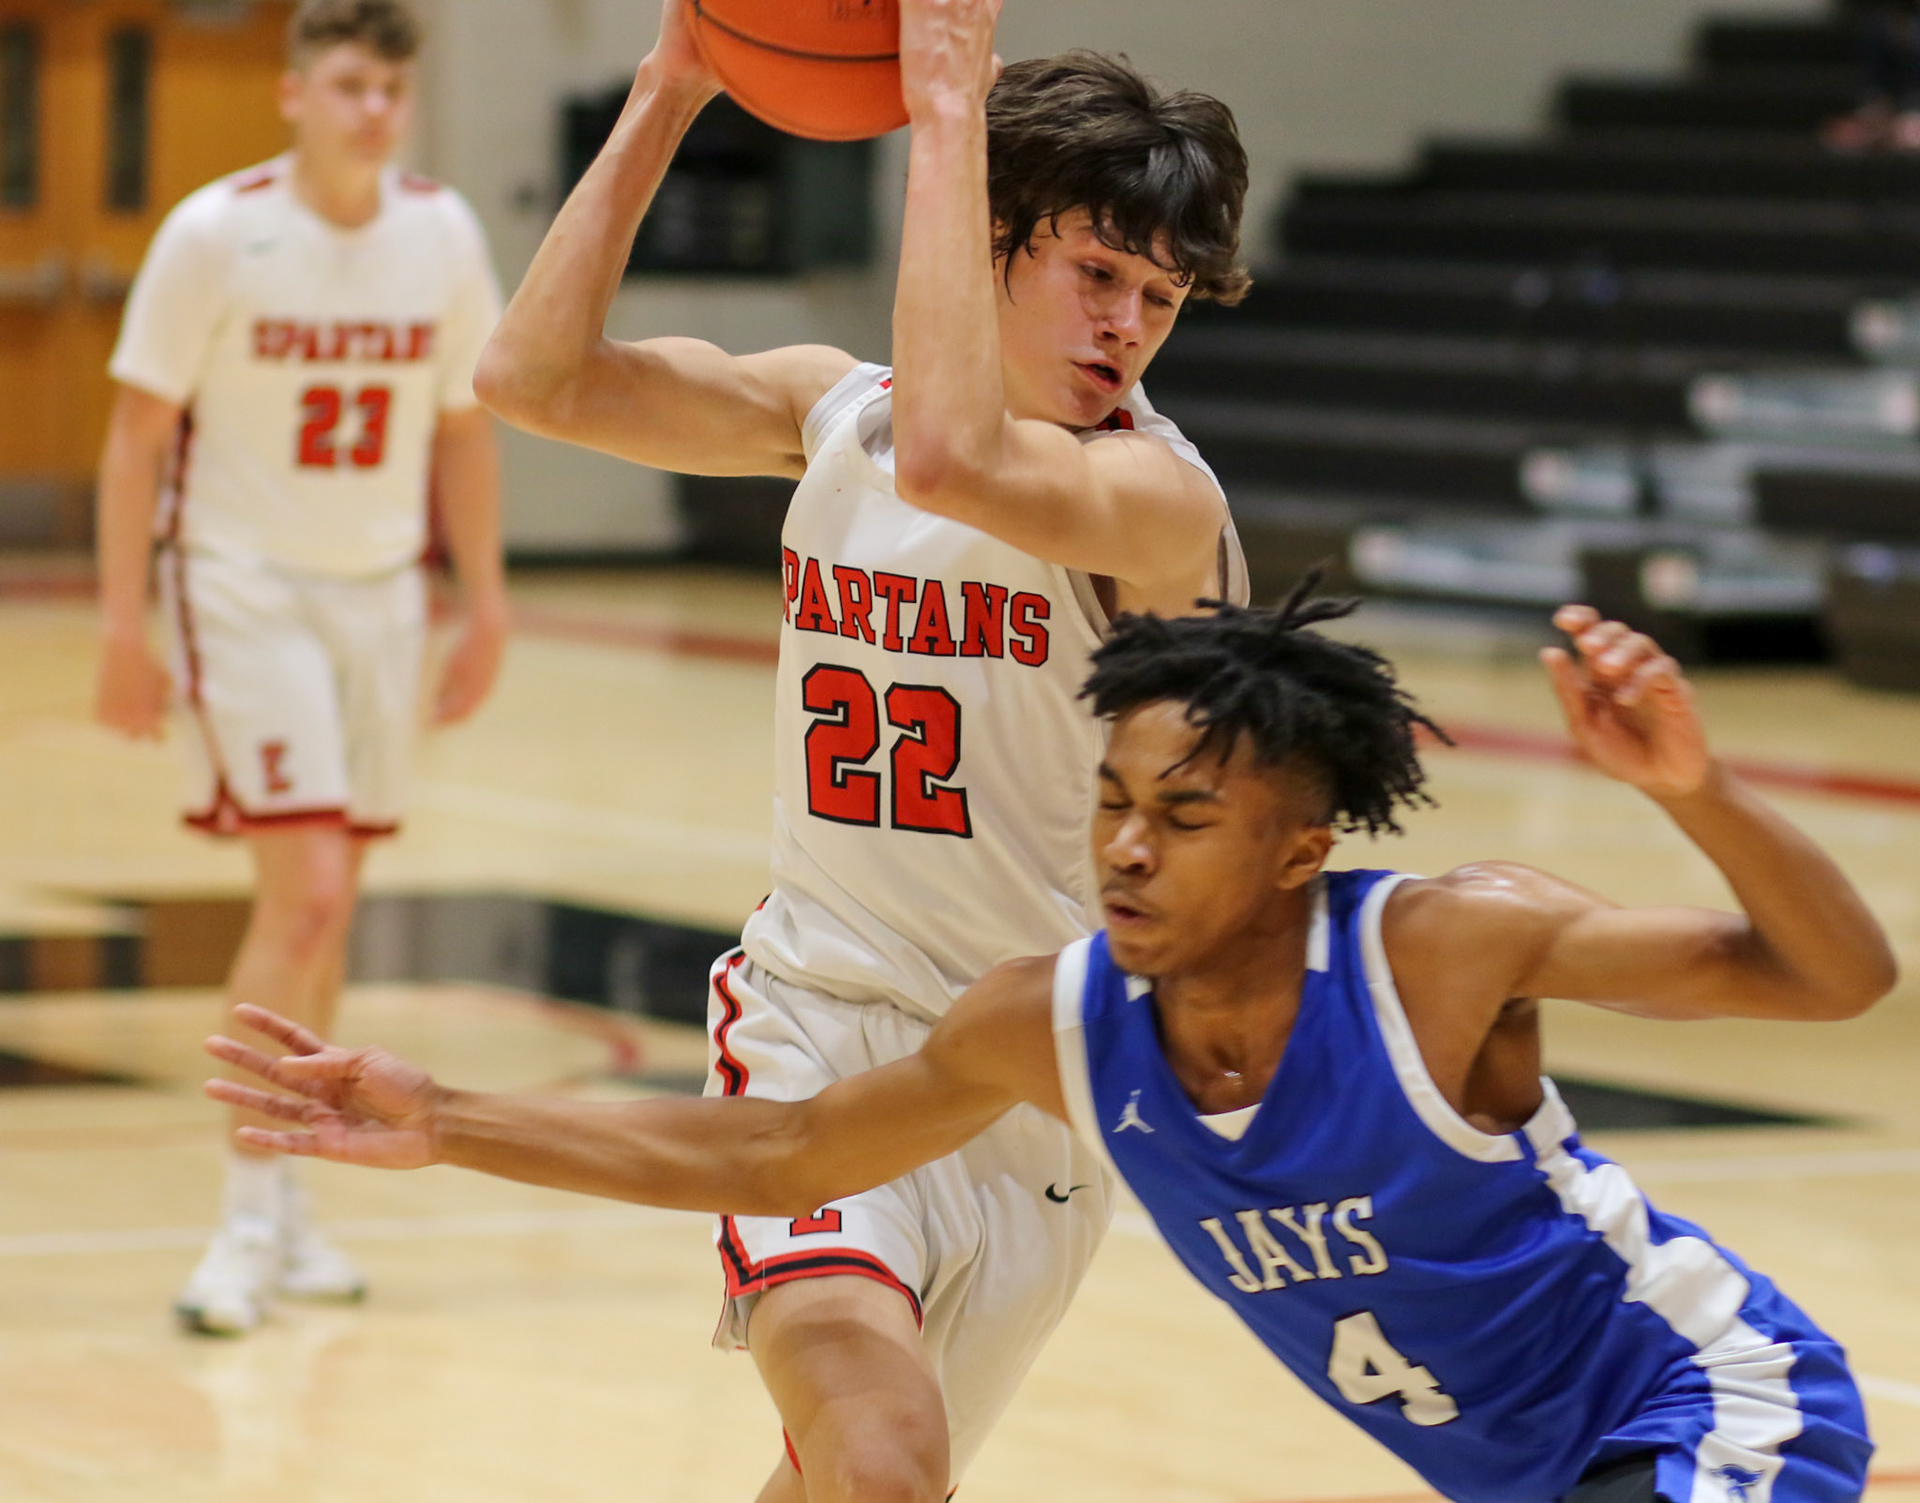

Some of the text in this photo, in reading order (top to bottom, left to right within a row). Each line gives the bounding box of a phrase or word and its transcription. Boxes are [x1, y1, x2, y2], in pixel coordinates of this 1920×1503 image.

[298, 385, 393, 468] 23
[782, 545, 1050, 668] PARTANS
[801, 662, 973, 838] 22
[1199, 1195, 1389, 1293] JAYS
[1327, 1310, 1460, 1427] 4
